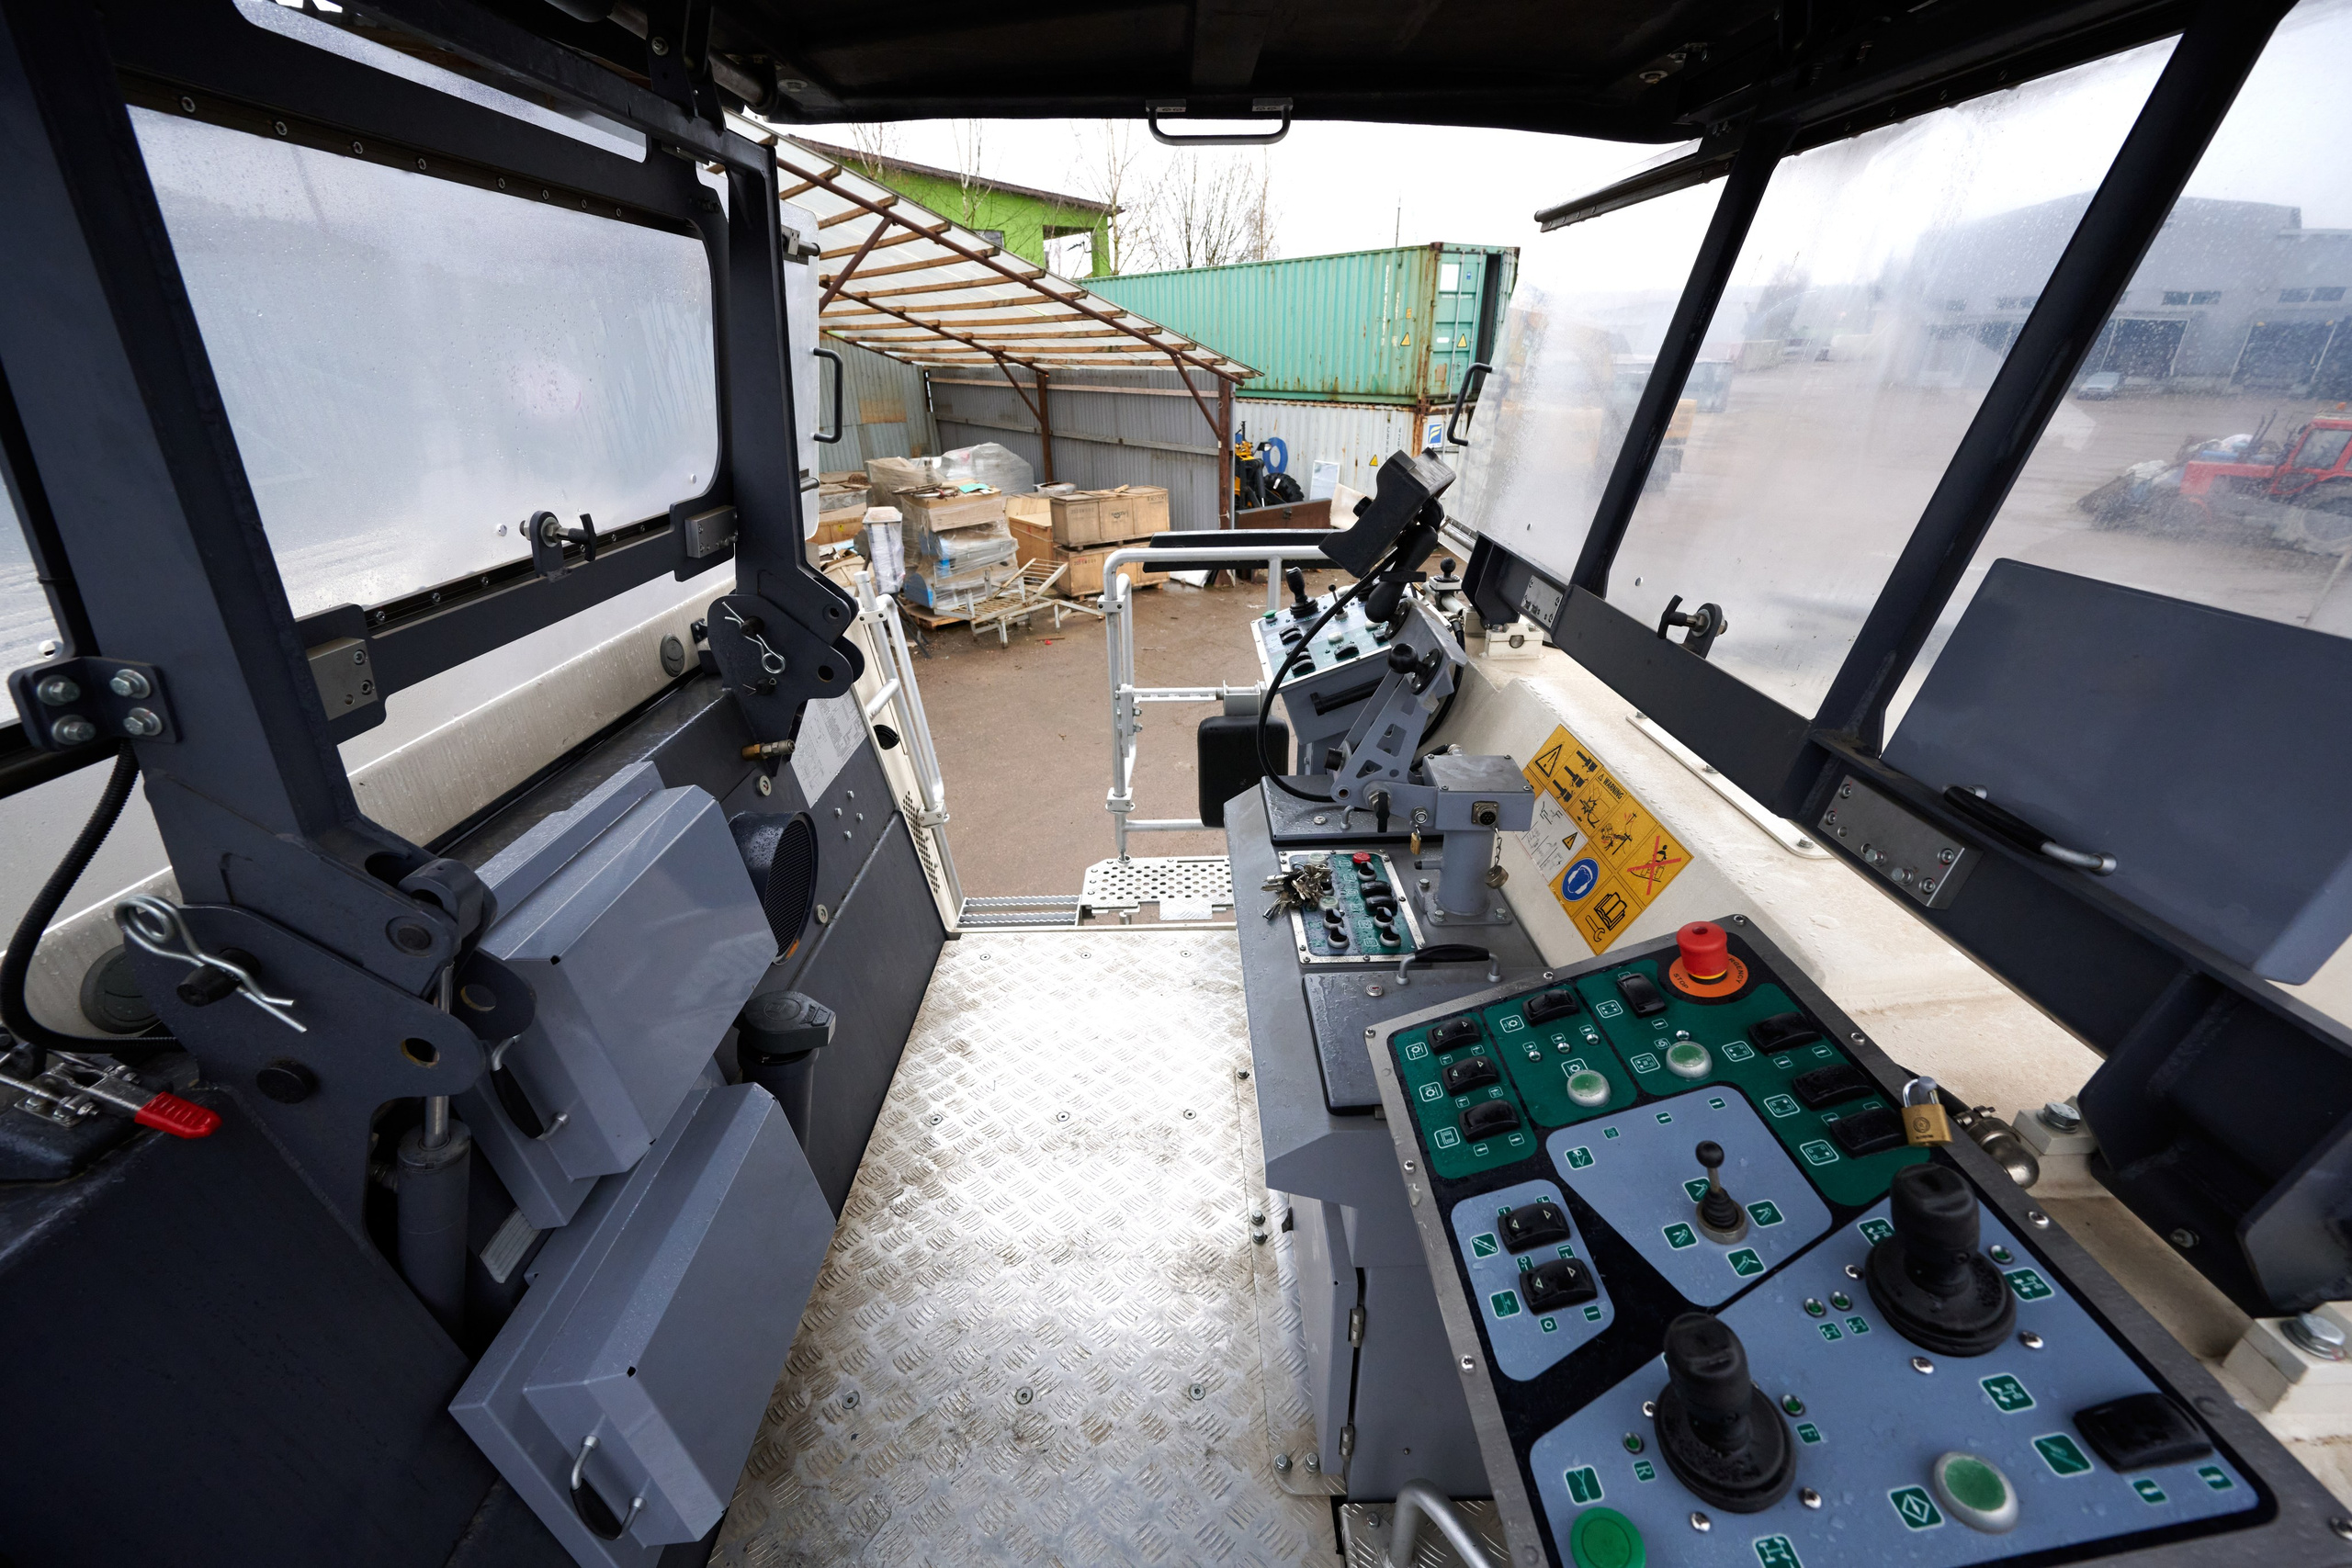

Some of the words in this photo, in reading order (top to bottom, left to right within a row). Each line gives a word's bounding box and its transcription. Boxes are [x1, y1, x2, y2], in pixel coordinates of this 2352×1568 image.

[1602, 777, 1624, 800] WARNING
[1728, 957, 1745, 984] RGENCY
[1673, 973, 1689, 989] STOP
[1635, 1464, 1653, 1478] R
